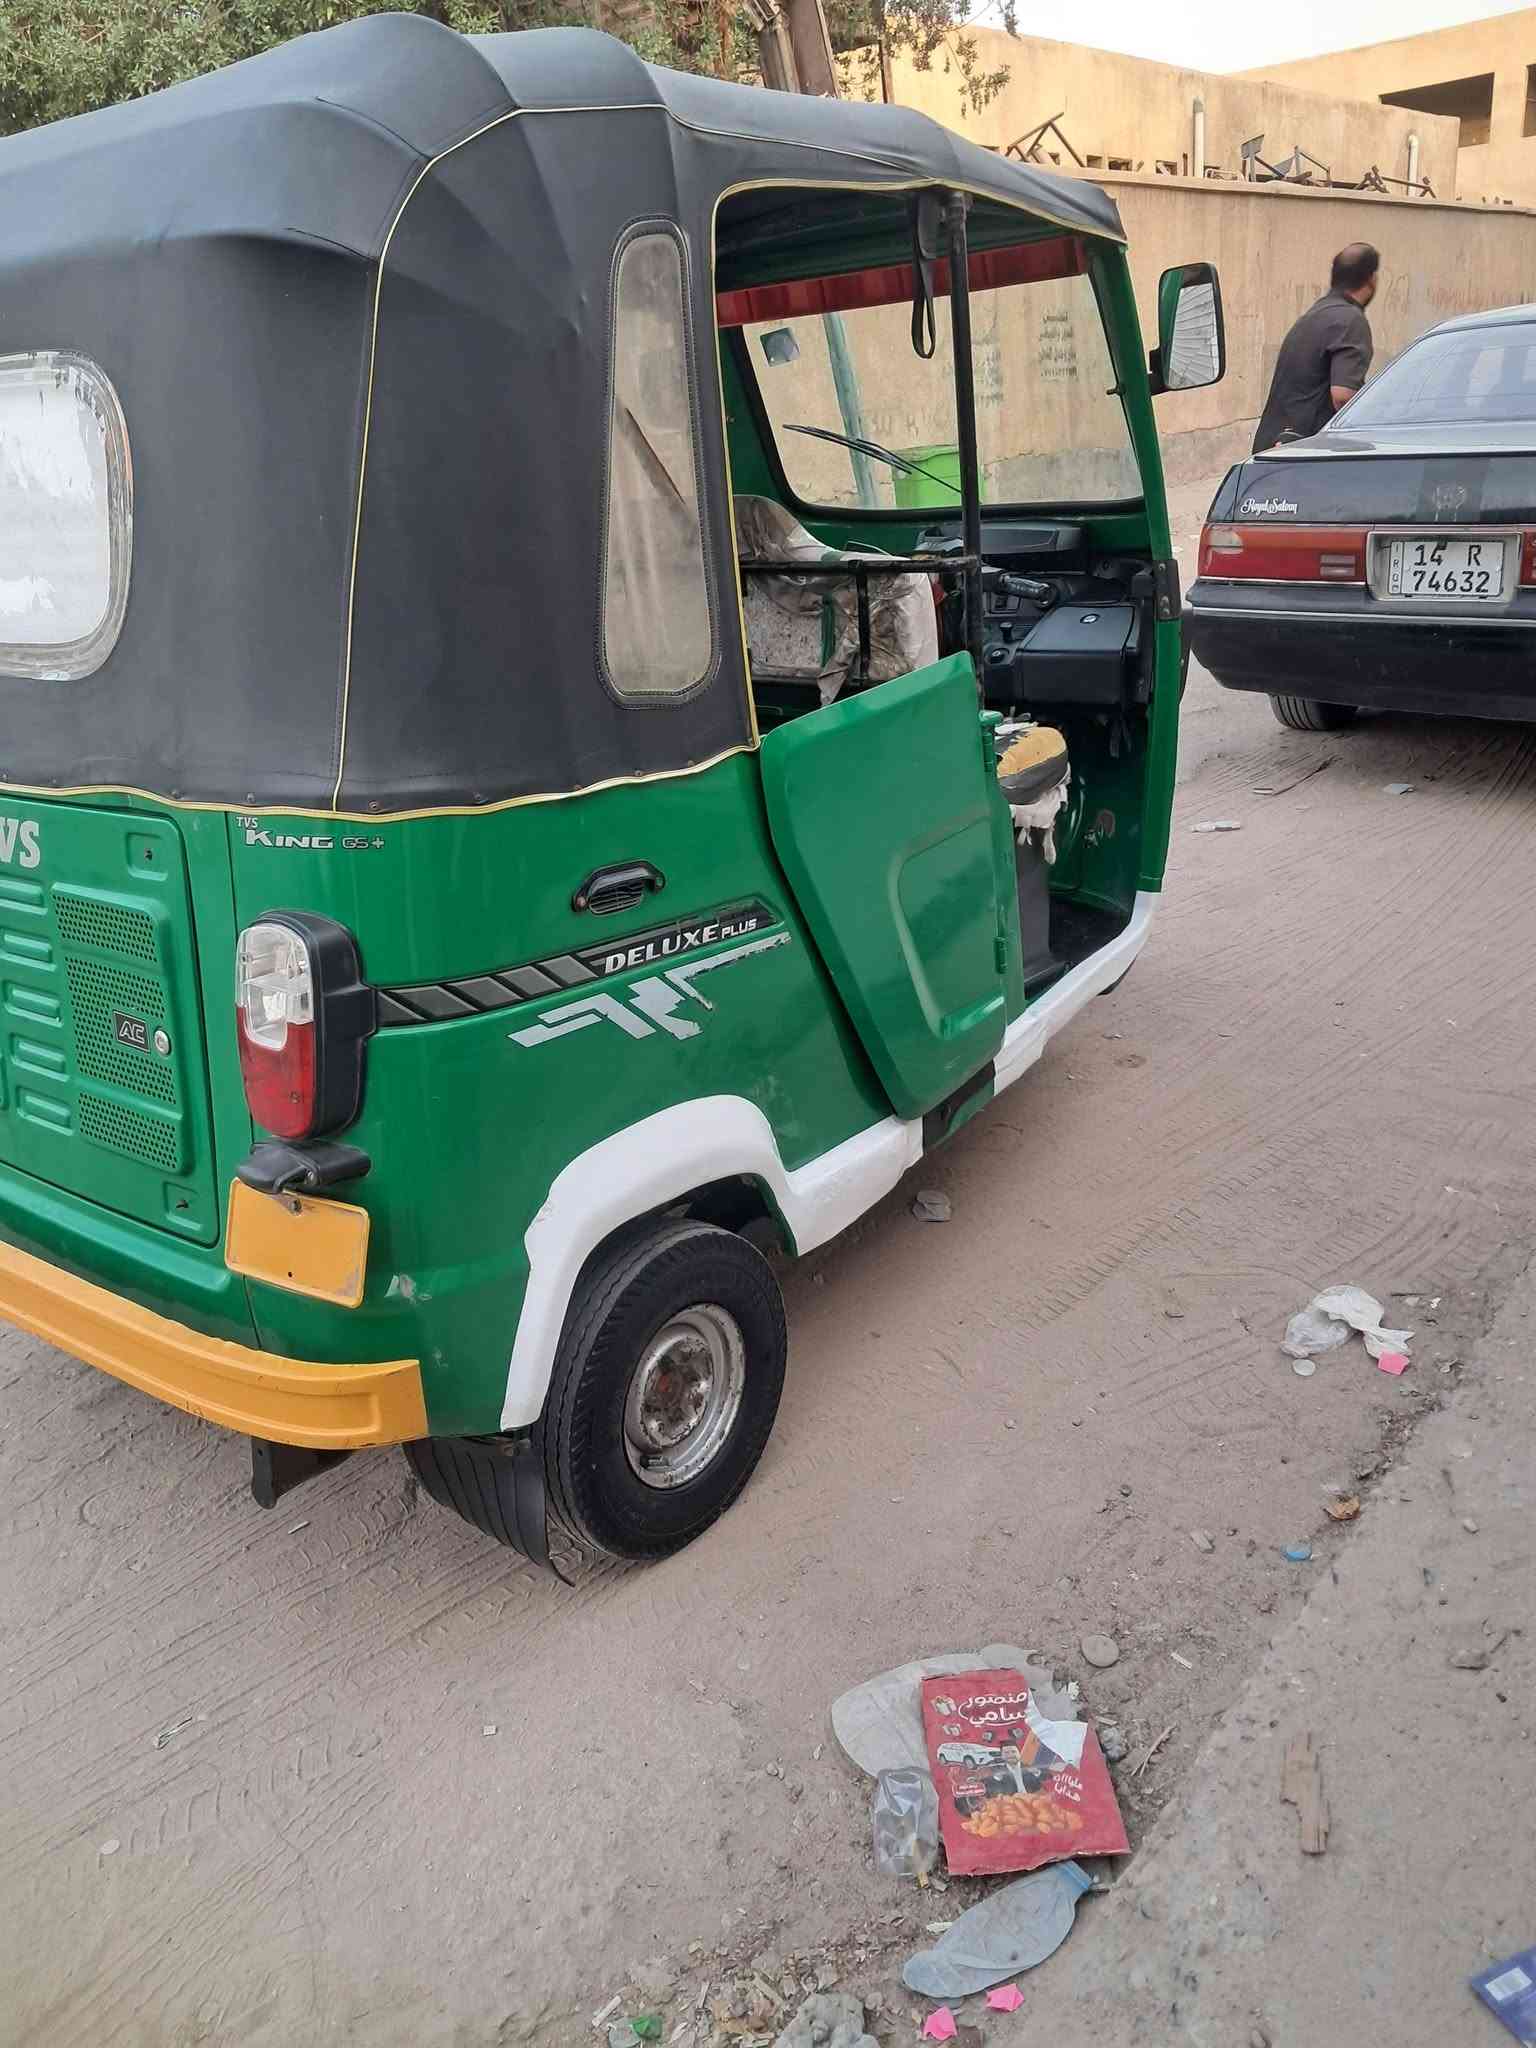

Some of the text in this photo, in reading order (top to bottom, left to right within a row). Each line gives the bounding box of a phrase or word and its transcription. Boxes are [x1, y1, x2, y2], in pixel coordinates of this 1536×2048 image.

[1414, 543, 1481, 566] 14 R
[1413, 570, 1490, 593] 74632
[236, 816, 258, 828] TVS
[342, 836, 385, 849] GS+
[604, 918, 758, 975] DELUXE PLUS
[965, 1692, 1027, 1708] منصور
